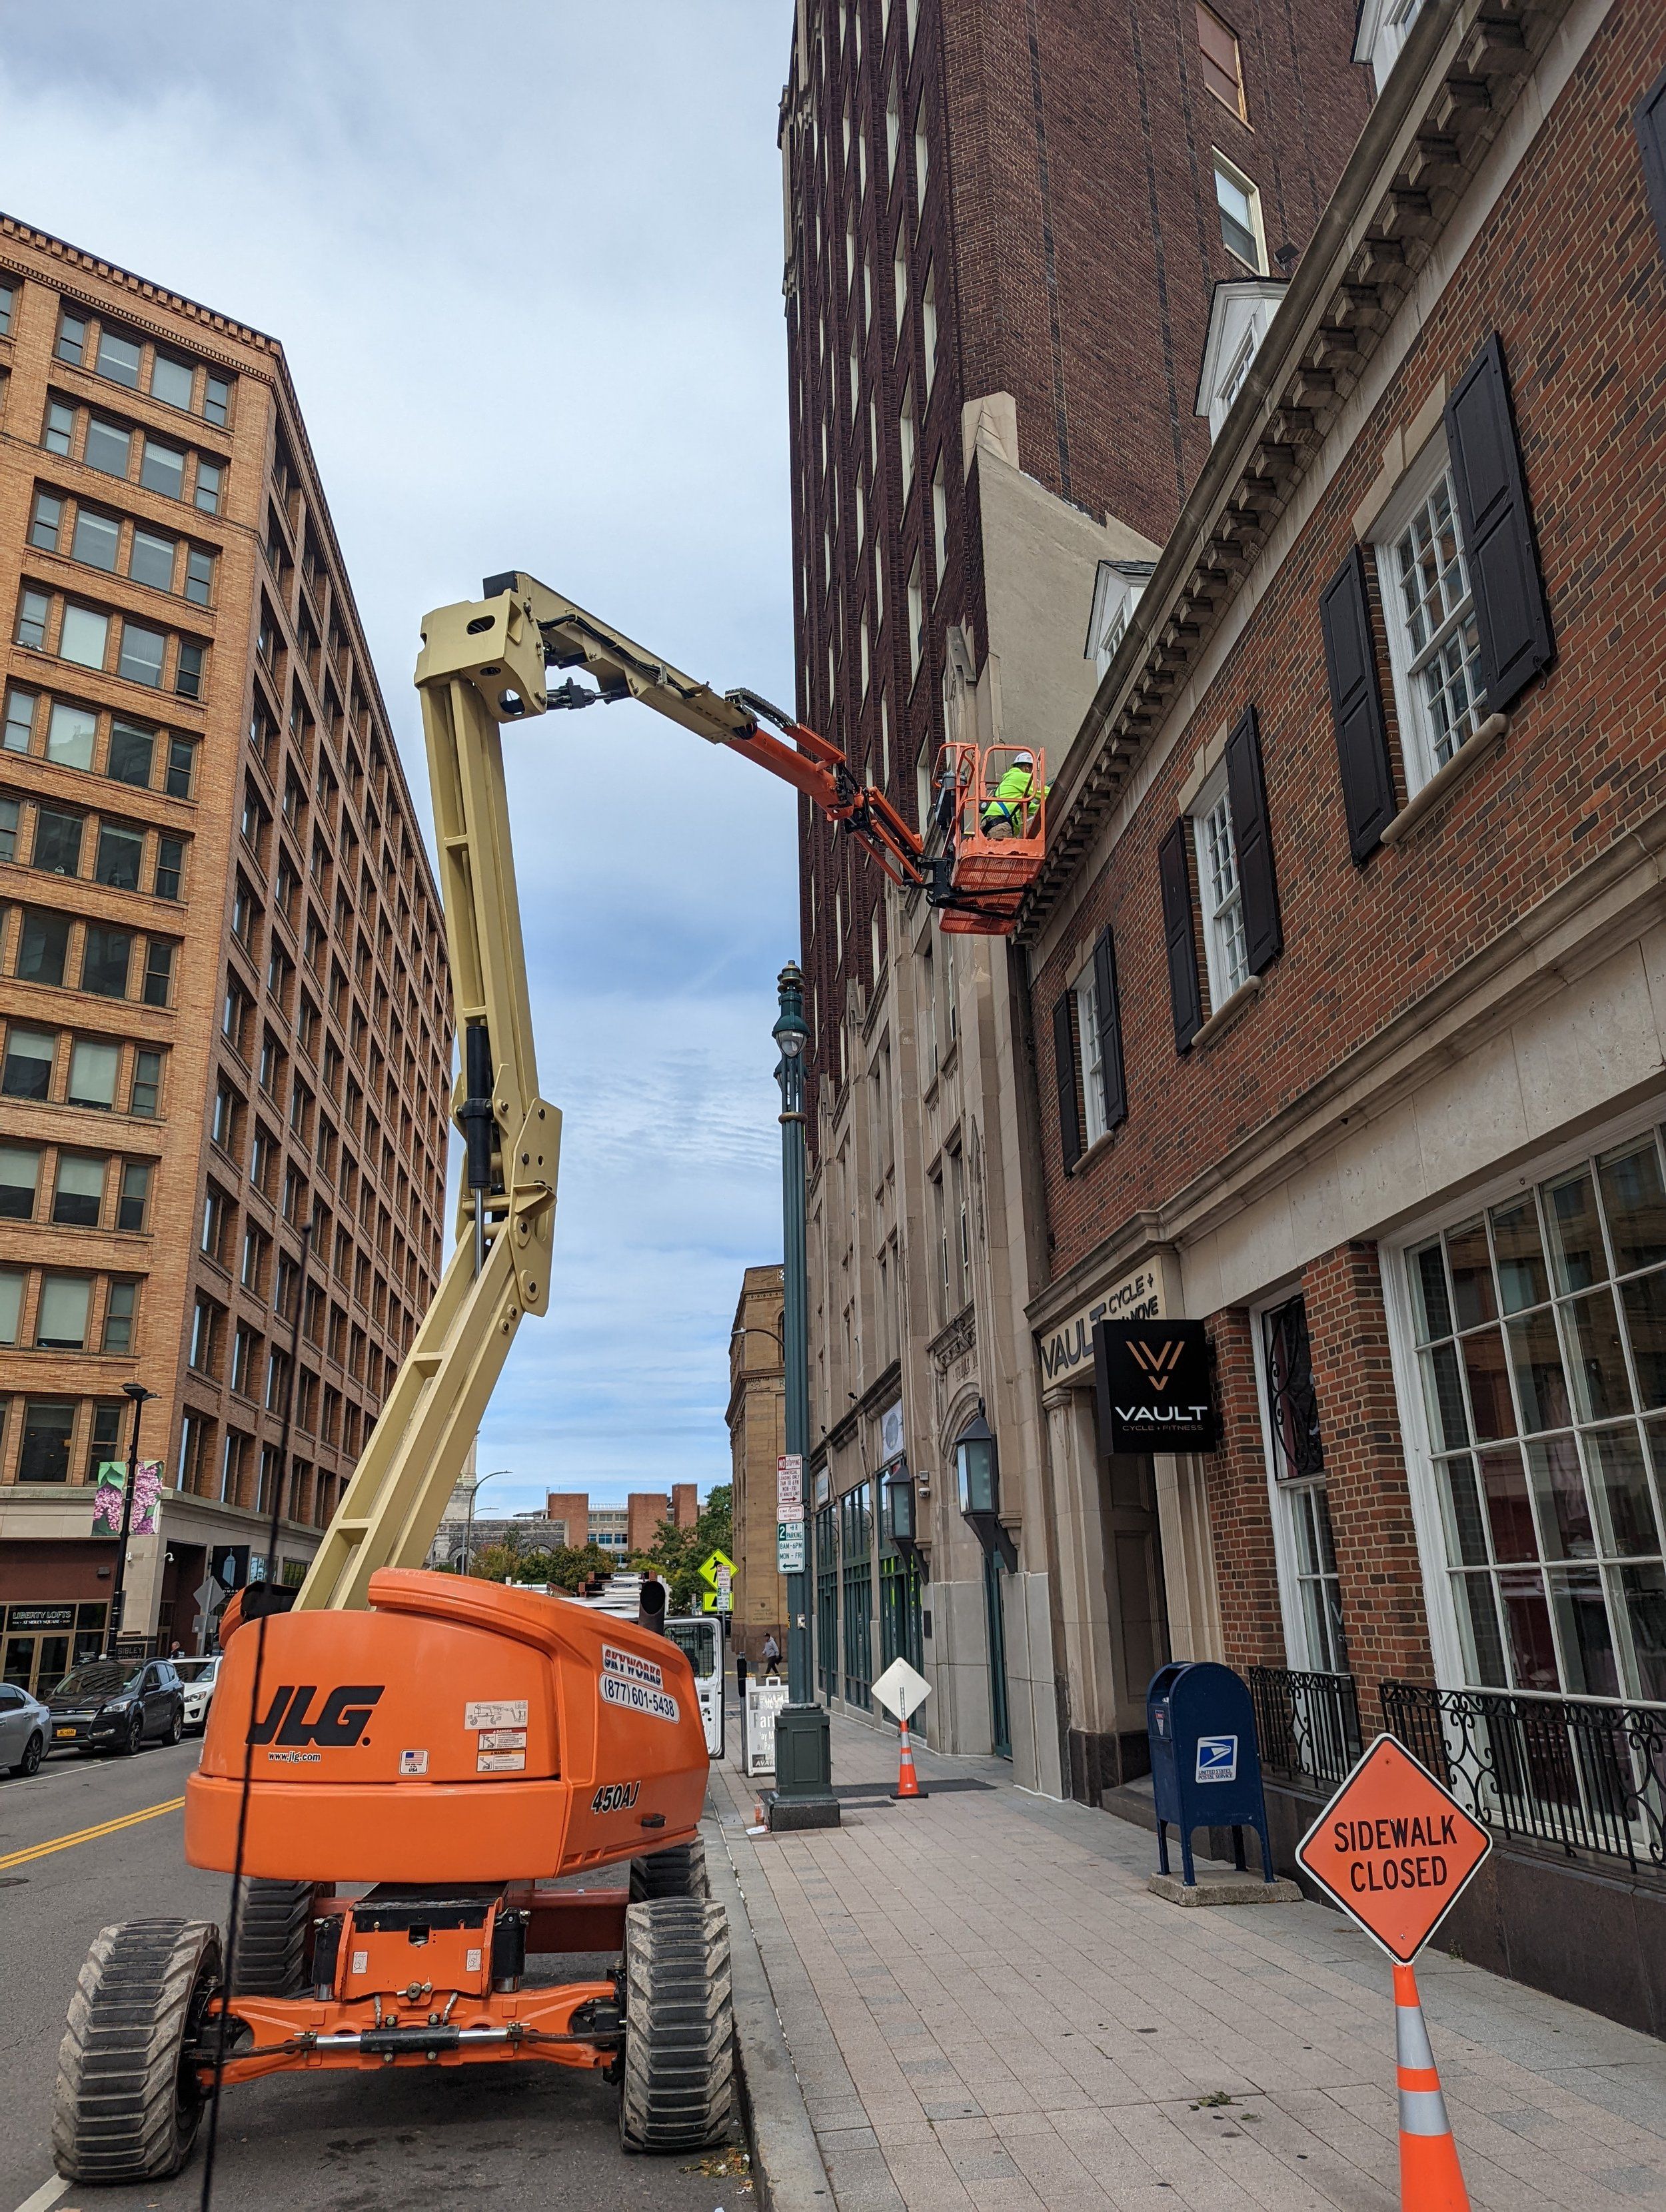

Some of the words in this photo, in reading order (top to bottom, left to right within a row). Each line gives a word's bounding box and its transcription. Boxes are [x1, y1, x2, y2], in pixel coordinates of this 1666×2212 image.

[1108, 1275, 1145, 1314] CYCLE
[1041, 1302, 1106, 1379] VAULT
[1114, 1406, 1208, 1421] VAULT
[778, 1459, 786, 1468] NO
[779, 1526, 786, 1538] 2
[604, 1648, 662, 1686] SKYWORKS
[268, 1752, 321, 1762] www.jlg.com
[592, 1782, 640, 1814] 450AJ
[1333, 1814, 1457, 1853] SIDEWALK
[1350, 1856, 1447, 1893] CLOSED
